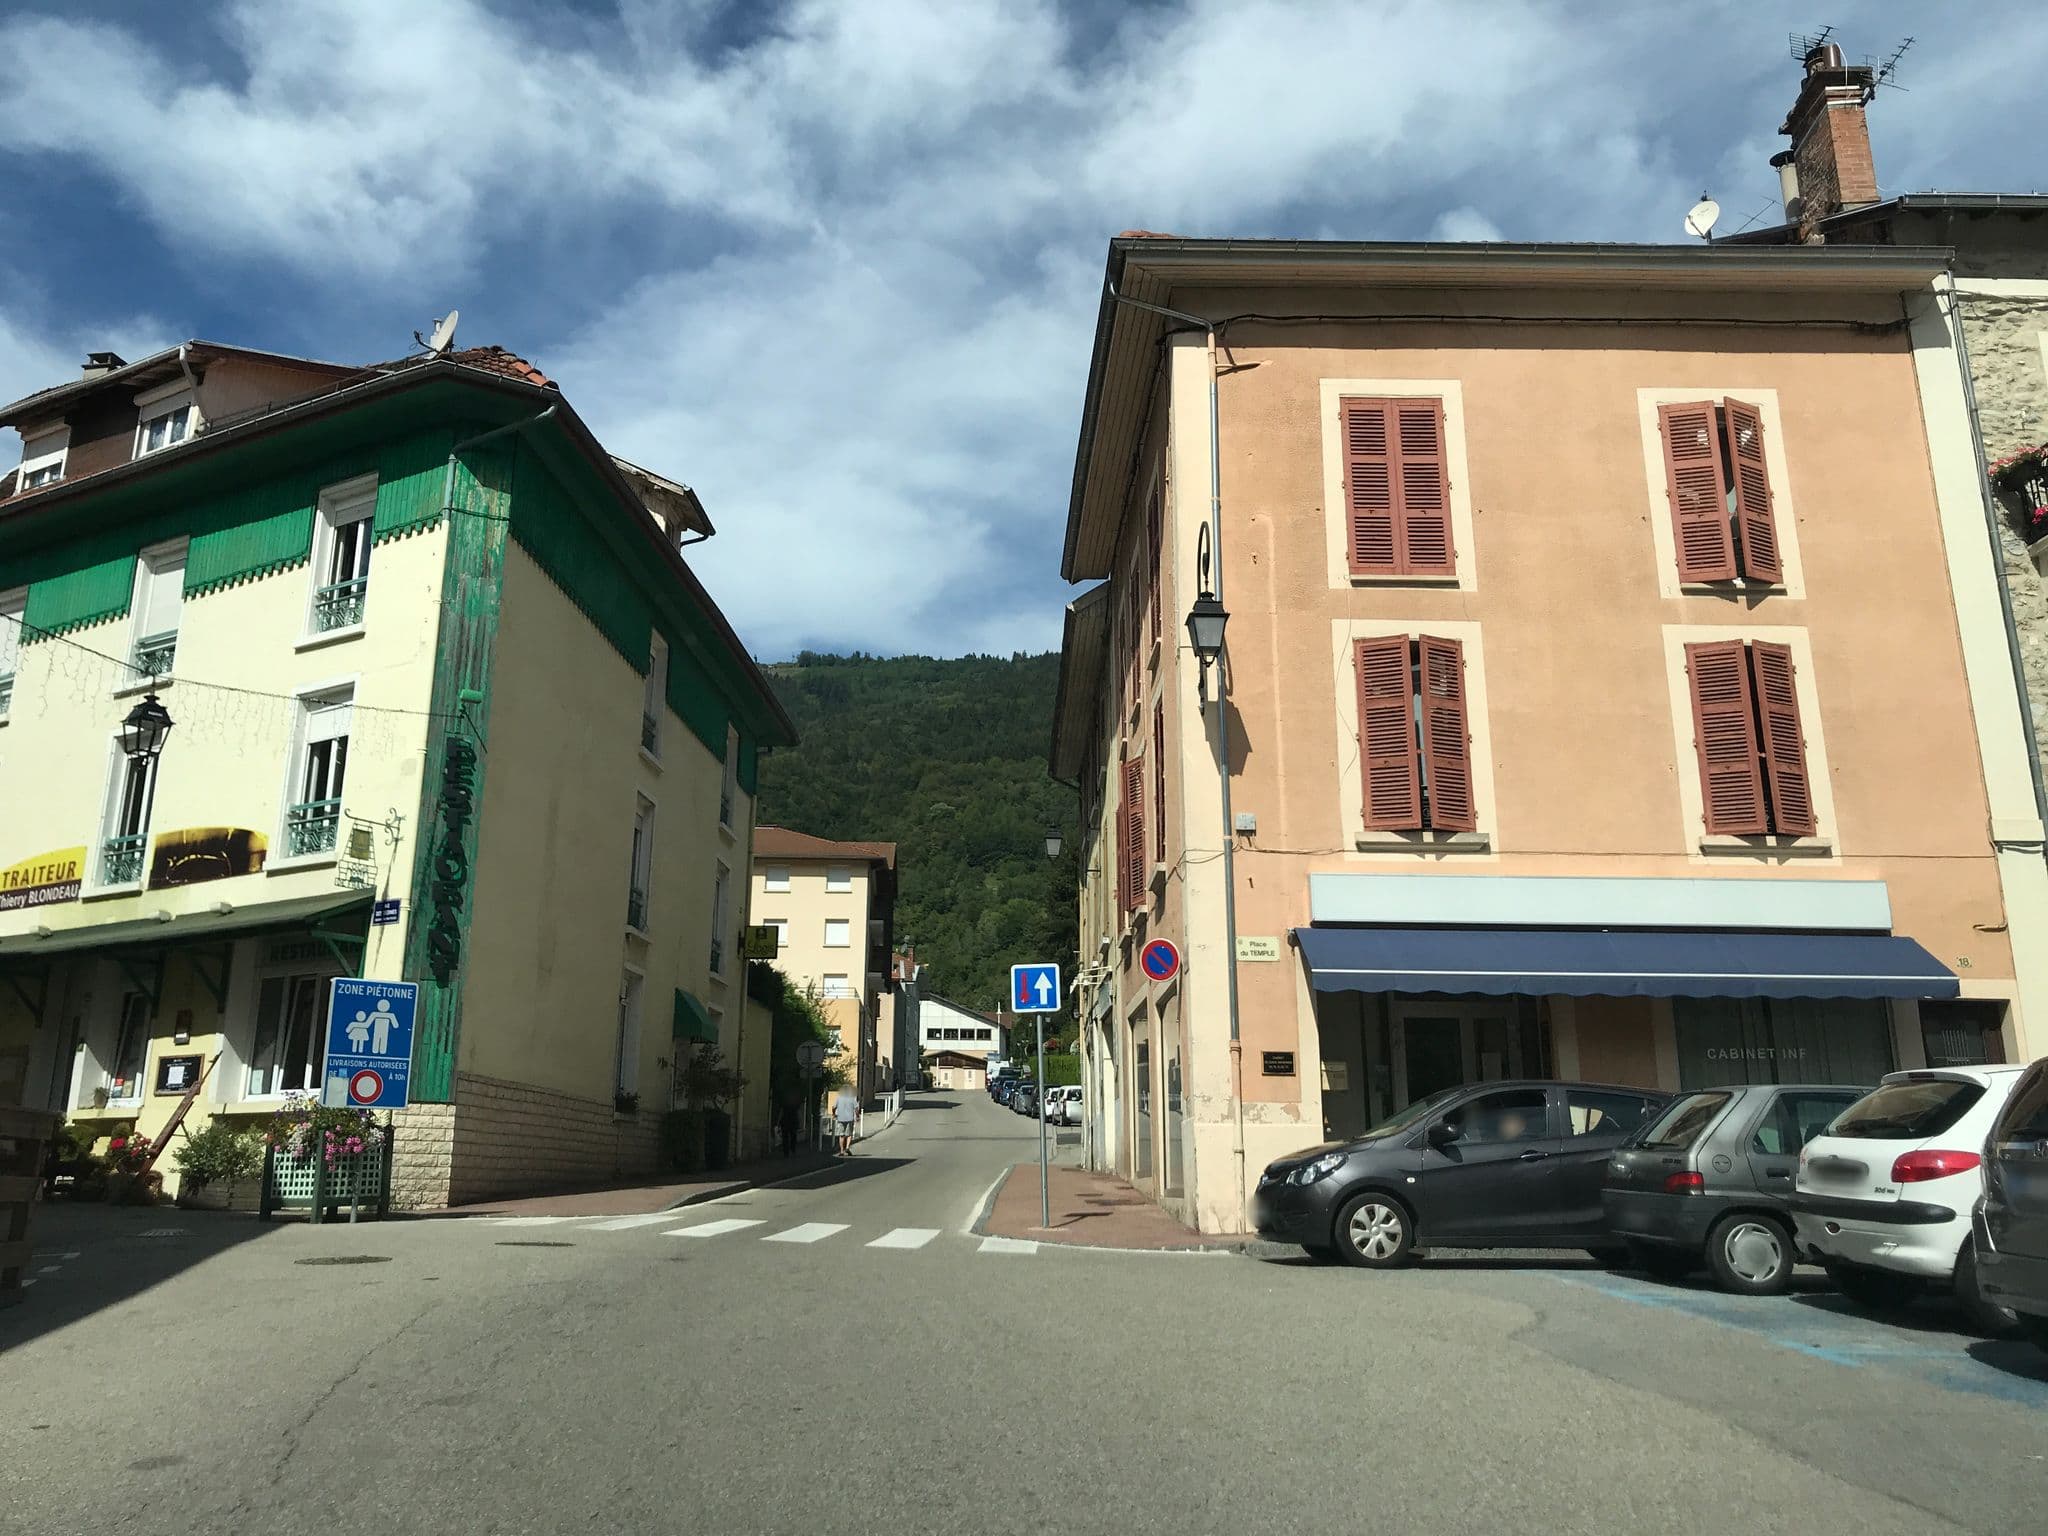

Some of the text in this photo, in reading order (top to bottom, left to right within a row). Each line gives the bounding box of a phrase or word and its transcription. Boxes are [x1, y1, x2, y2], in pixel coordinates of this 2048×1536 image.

[3, 860, 77, 889] TRAITEUR
[28, 883, 80, 904] BLONDEAU
[1958, 957, 1970, 967] 18
[337, 983, 414, 1000] ZONE PIÉTONNE
[1705, 1047, 1775, 1059] CABINET
[329, 1058, 408, 1070] LIVRAISONS AUTORISÉES
[394, 1073, 406, 1081] 10h
